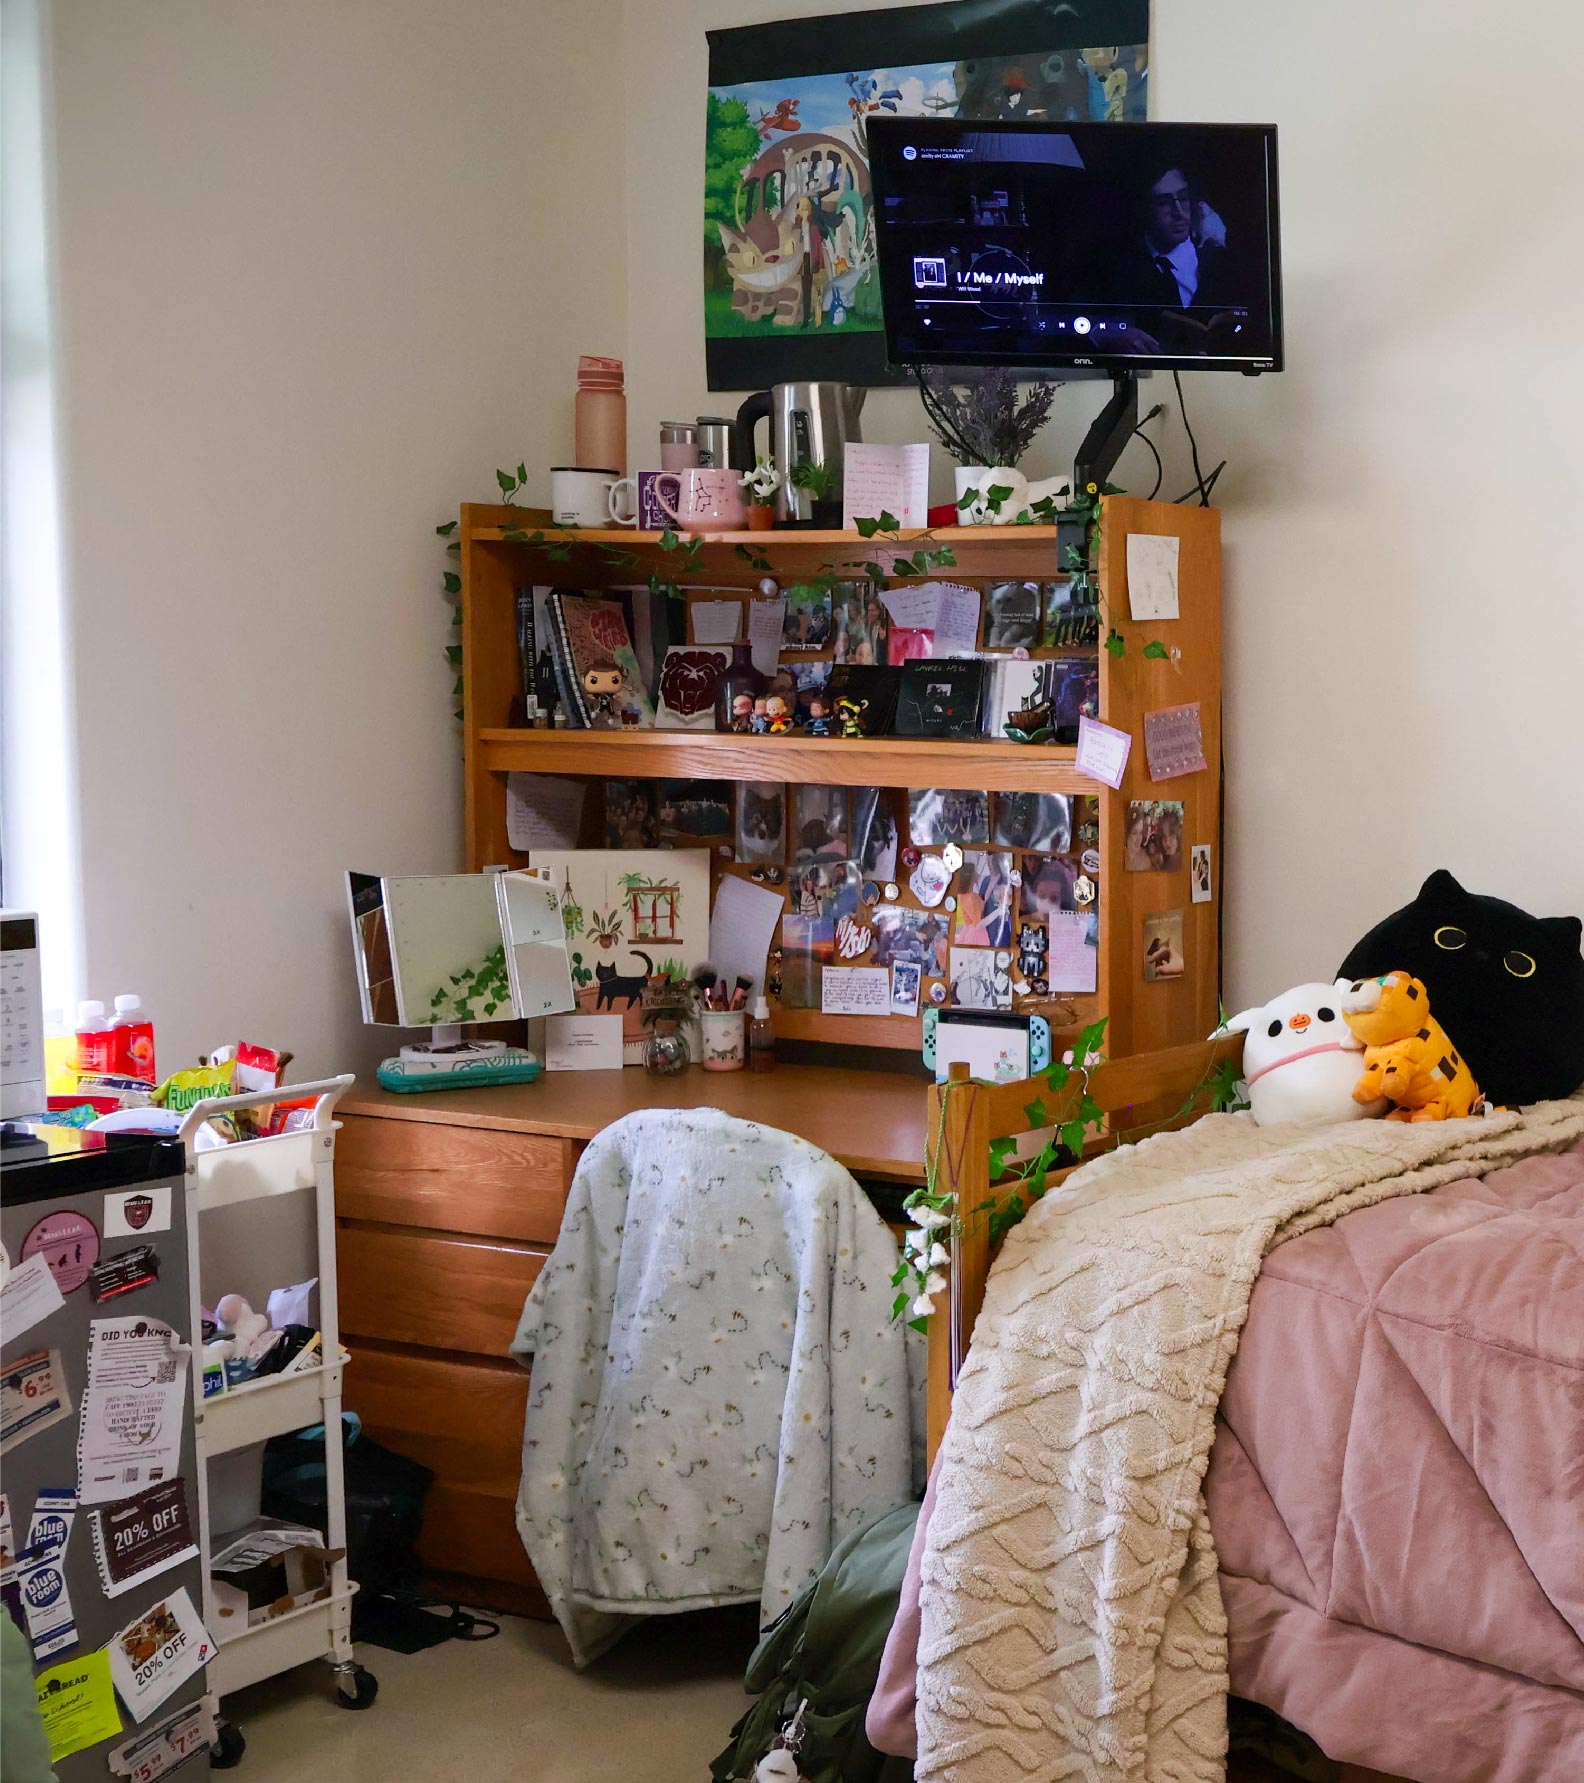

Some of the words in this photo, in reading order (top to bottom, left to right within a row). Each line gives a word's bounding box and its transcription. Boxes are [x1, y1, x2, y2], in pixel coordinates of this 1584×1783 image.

[974, 272, 993, 284] Me
[1004, 272, 1044, 286] Myself
[101, 1331, 120, 1342] DID
[34, 1519, 64, 1538] blue
[114, 1520, 148, 1551] 20%
[152, 1504, 179, 1532] OFF
[28, 1570, 57, 1597] blue
[32, 1580, 61, 1604] room
[135, 1656, 163, 1686] 20%
[163, 1632, 188, 1660] OFF
[134, 1753, 162, 1781] $5.99
